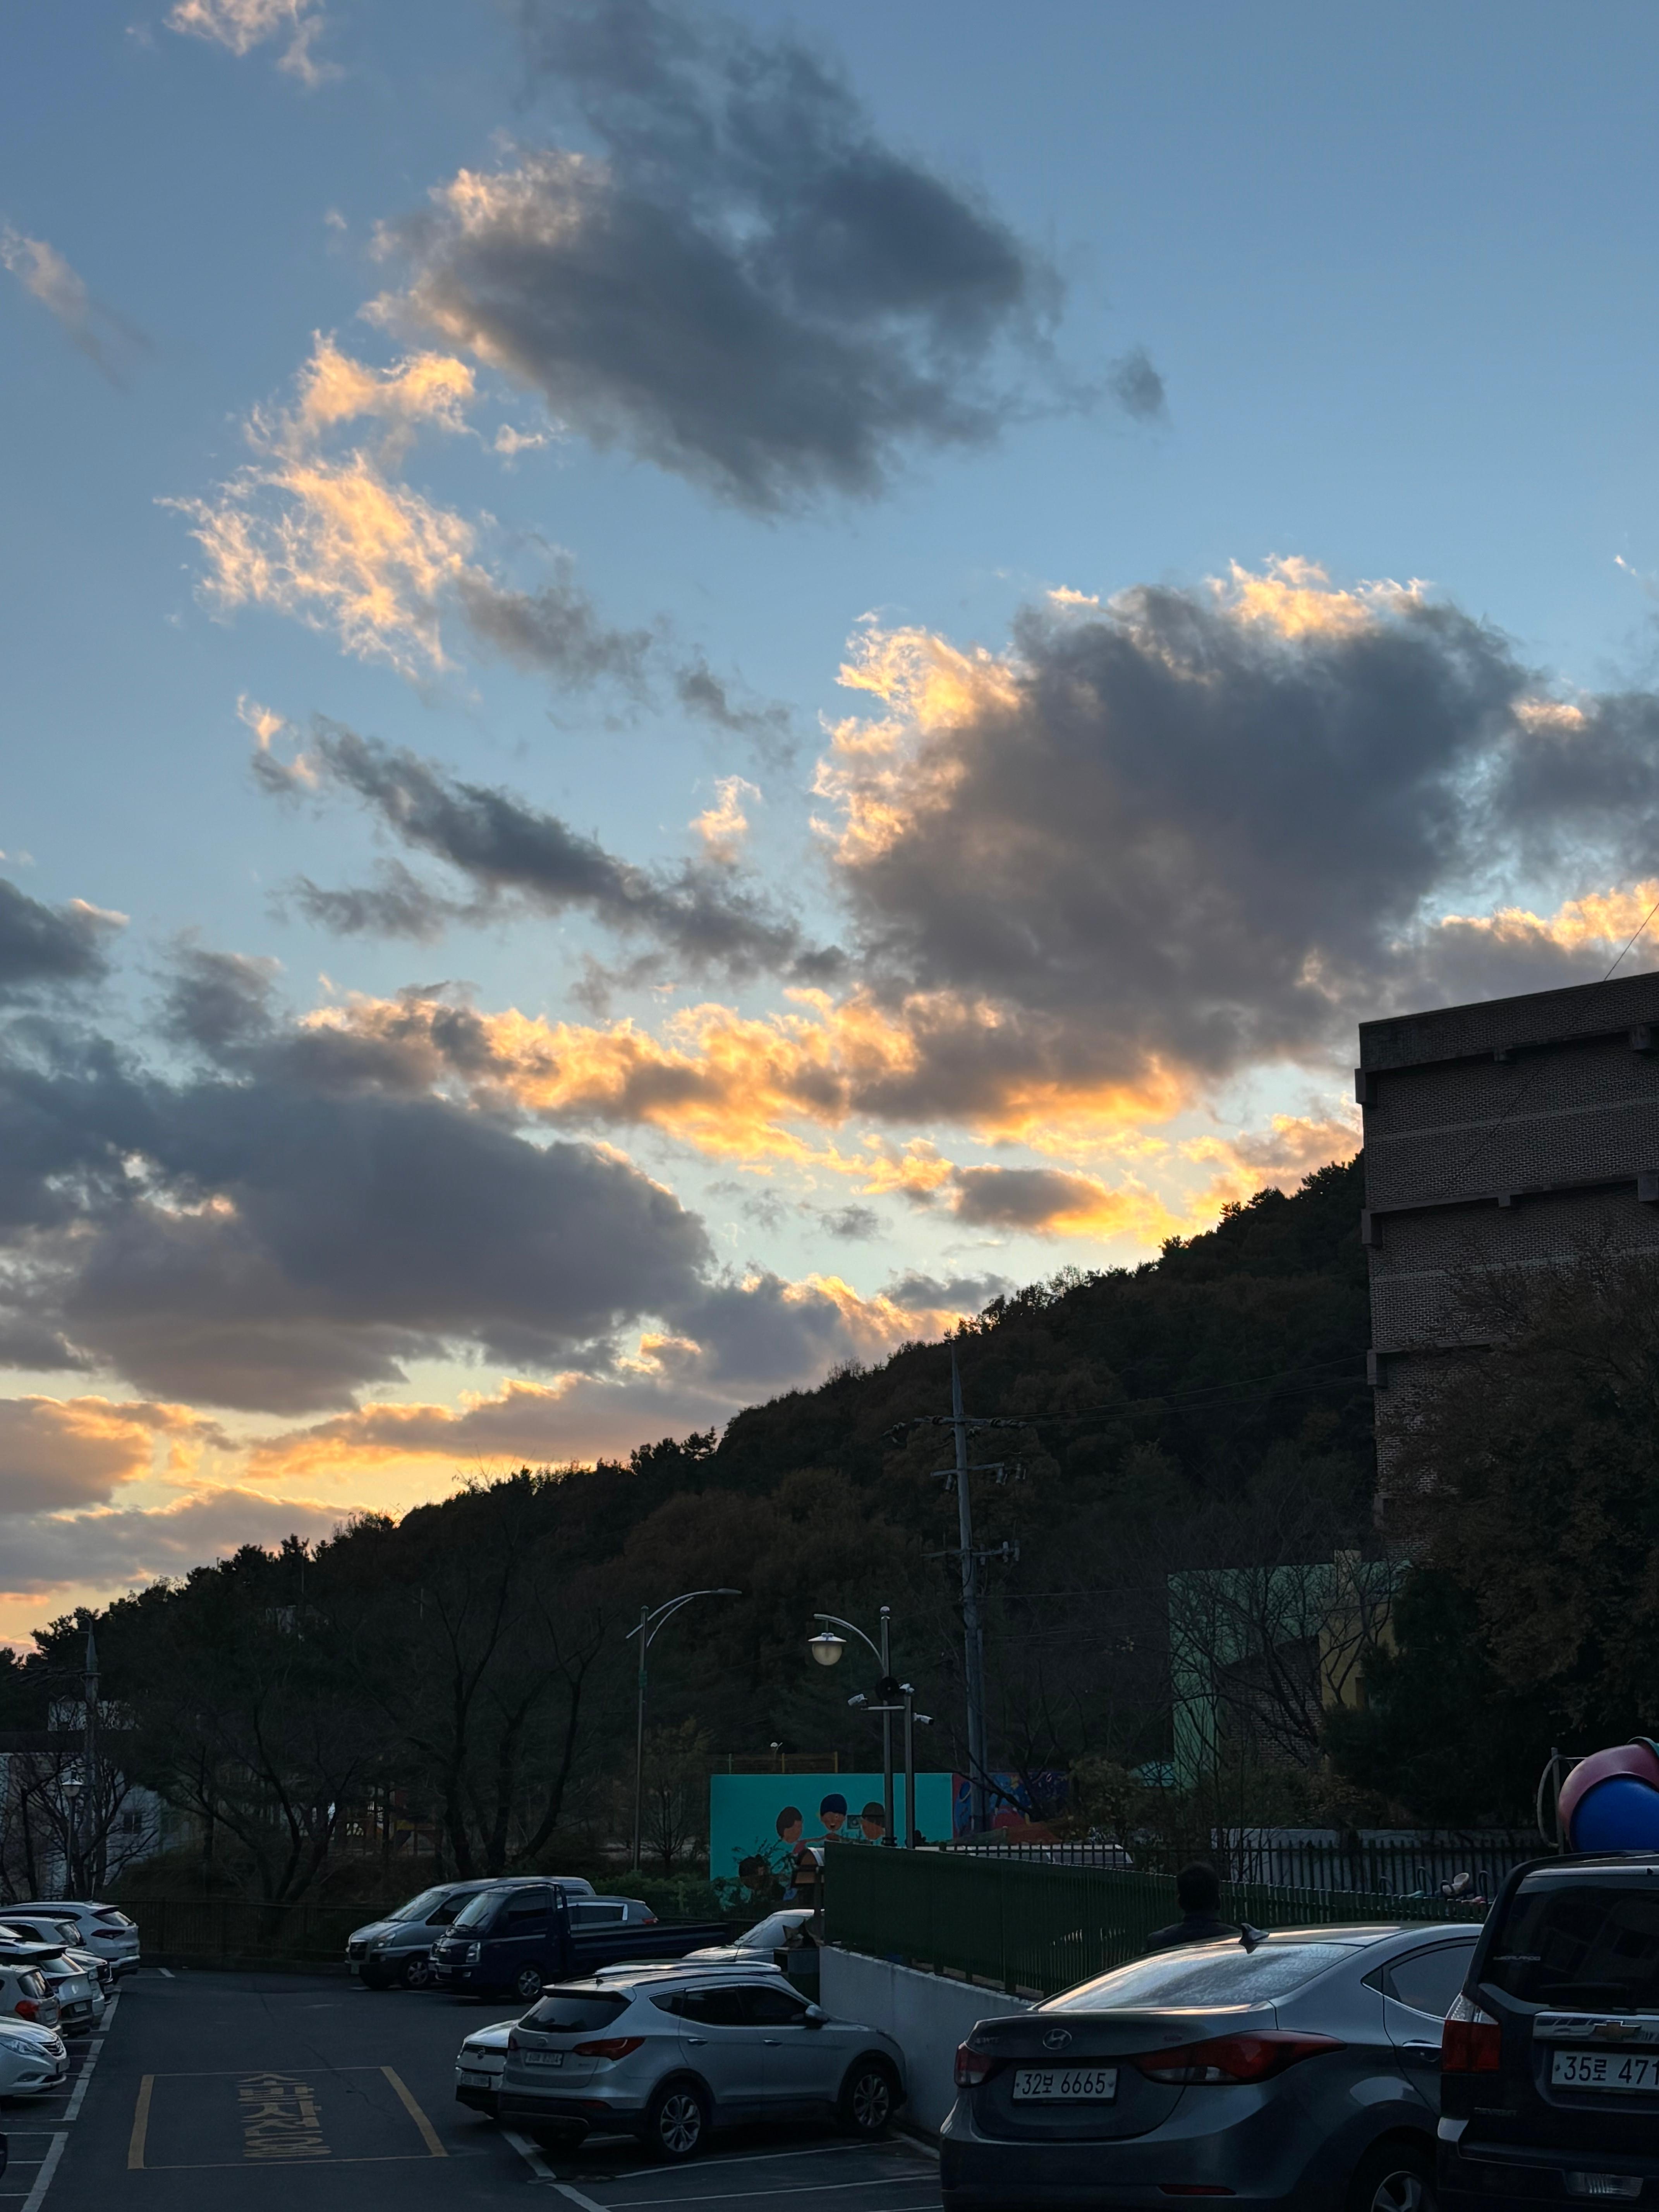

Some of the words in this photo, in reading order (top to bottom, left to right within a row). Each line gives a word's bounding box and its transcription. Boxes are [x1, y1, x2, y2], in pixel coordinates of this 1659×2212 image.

[1564, 2056, 1607, 2081] 35로
[1022, 2073, 1053, 2094] 32보
[1061, 2072, 1106, 2094] 6665
